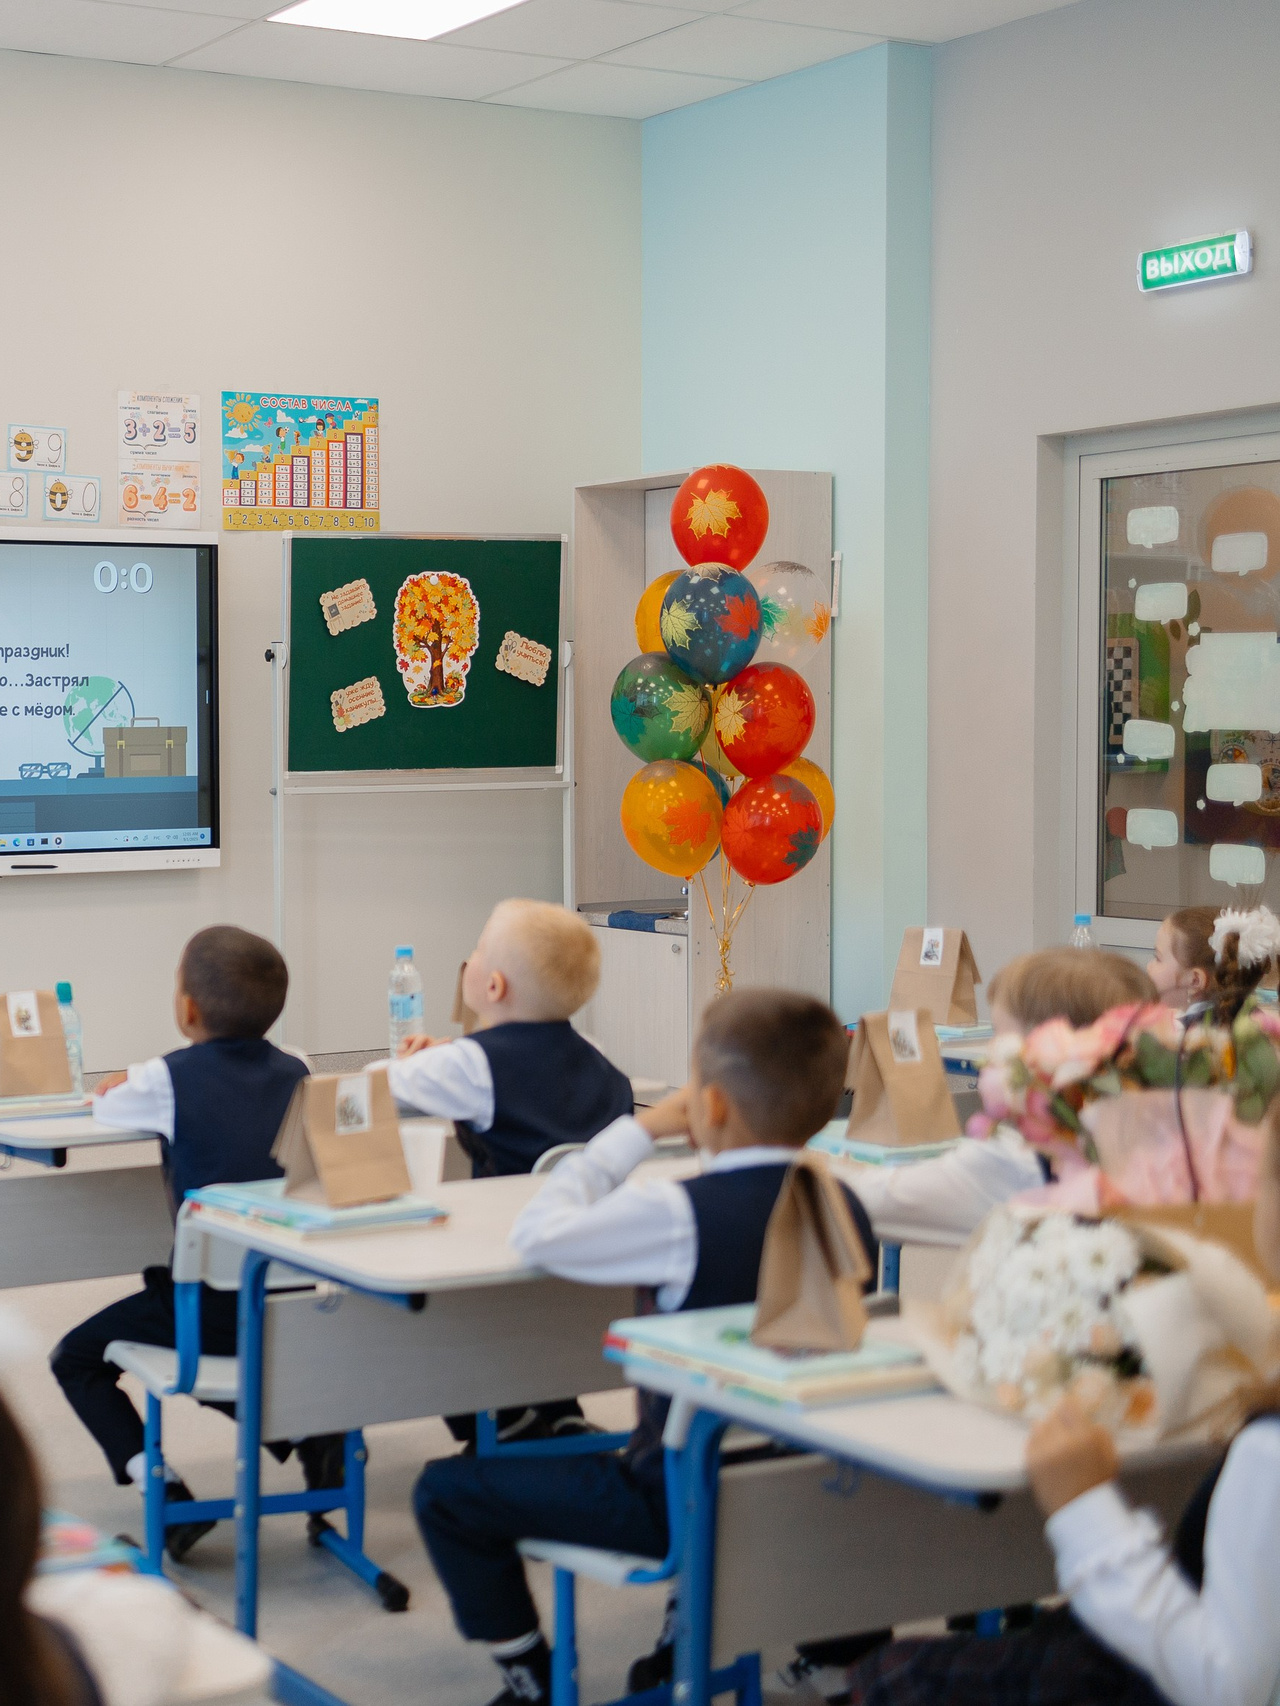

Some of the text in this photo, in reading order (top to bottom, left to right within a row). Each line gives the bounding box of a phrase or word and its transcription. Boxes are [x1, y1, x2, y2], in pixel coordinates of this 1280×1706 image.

[1146, 243, 1232, 280] ВЫХОД
[259, 396, 353, 412] СОСТАВ ЧИСЛА
[14, 432, 34, 463] 9
[48, 481, 69, 512] 0
[228, 514, 375, 527] 1 2 3 4 5 6 7 8 9 10
[93, 560, 155, 596] 0:0
[516, 649, 546, 667] учиться!
[520, 641, 547, 658] Люблю
[11, 703, 21, 718] с
[23, 702, 76, 722] мёдом.
